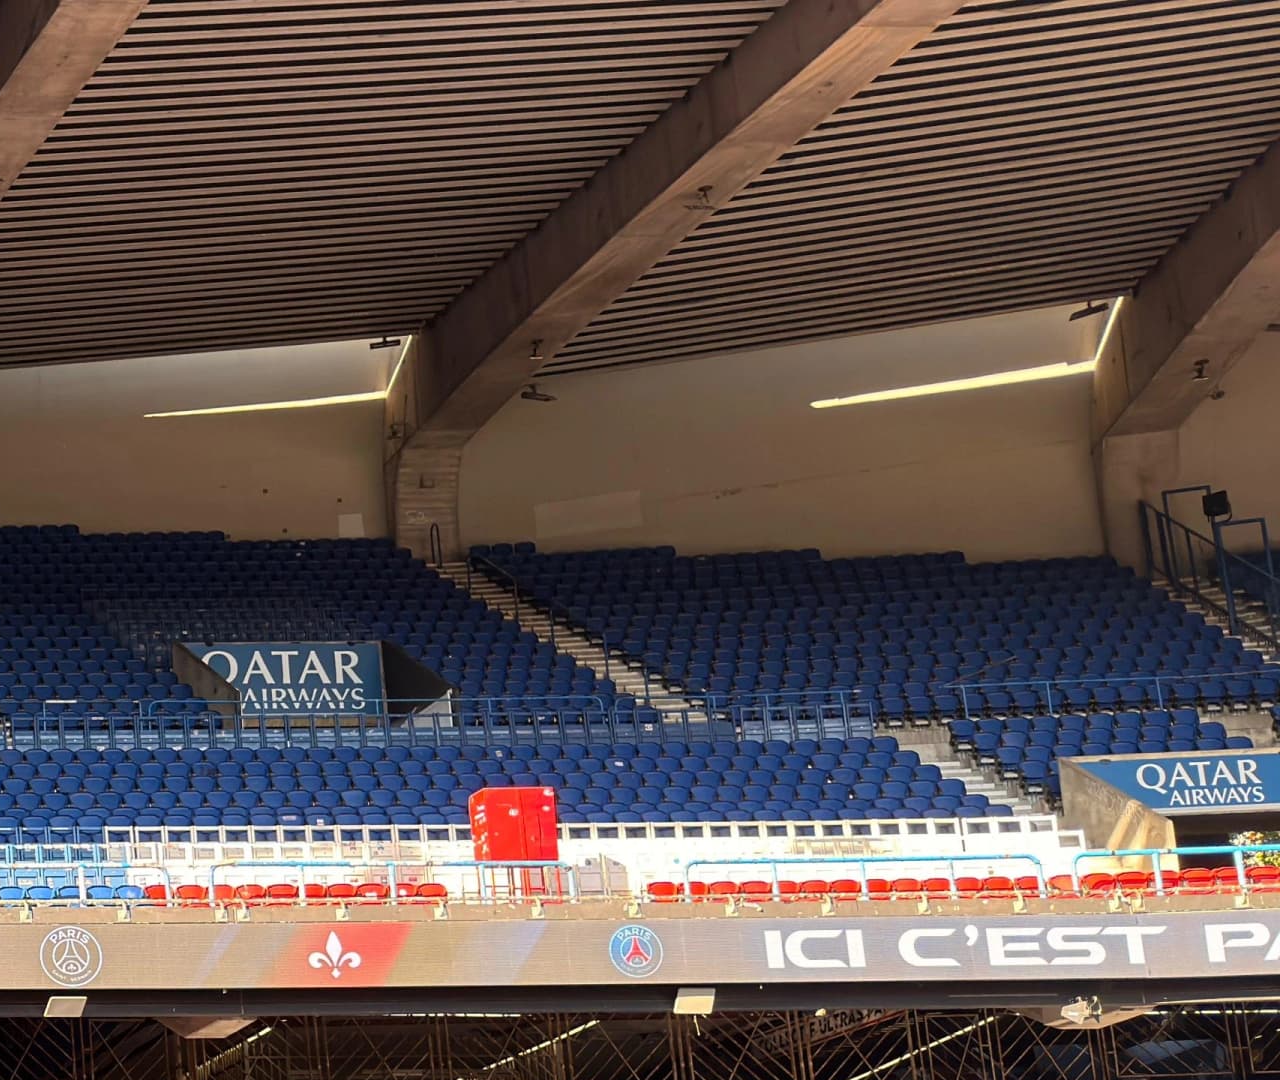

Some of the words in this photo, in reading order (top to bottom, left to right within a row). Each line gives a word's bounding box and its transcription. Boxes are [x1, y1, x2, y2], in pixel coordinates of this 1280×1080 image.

[1136, 759, 1262, 794] QATAR
[1169, 786, 1265, 806] AIRWAYS
[49, 929, 90, 944] PARIS
[617, 928, 652, 940] PARIS
[764, 928, 867, 968] ICI
[897, 925, 1167, 967] C'EST
